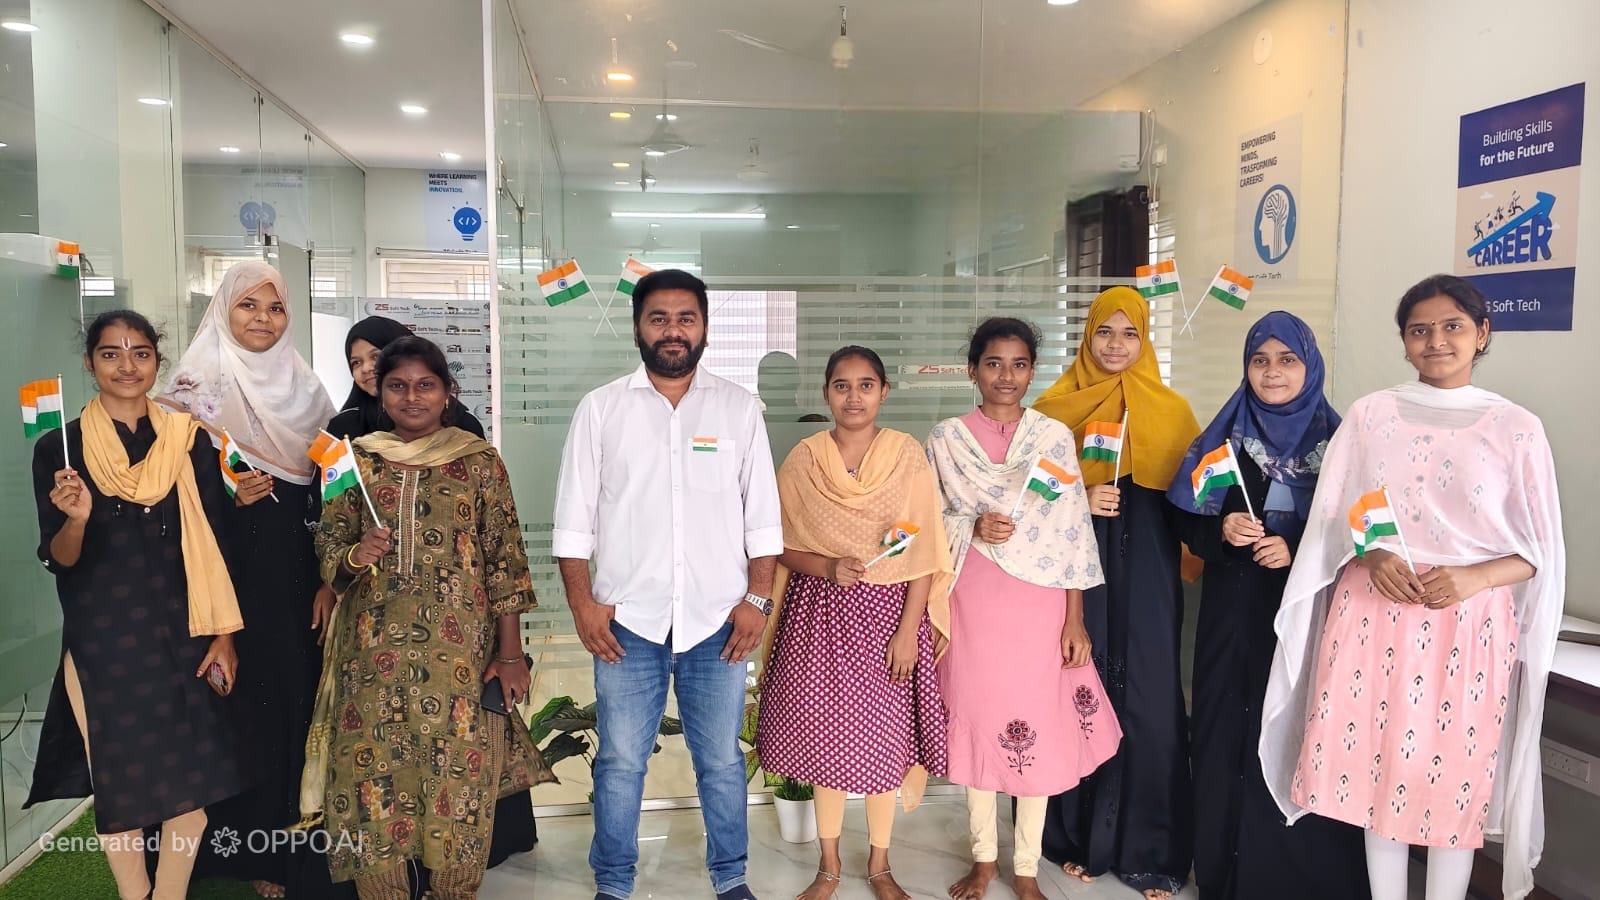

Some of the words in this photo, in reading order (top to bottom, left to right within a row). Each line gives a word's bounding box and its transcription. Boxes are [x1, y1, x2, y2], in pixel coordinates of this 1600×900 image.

[1241, 131, 1276, 151] EMPOWERING
[1483, 127, 1523, 147] Building
[1525, 118, 1553, 138] Skills
[1240, 150, 1259, 163] MINDS,
[1480, 153, 1495, 167] for
[1497, 147, 1515, 163] the
[1517, 141, 1555, 160] Future
[1240, 173, 1264, 188] CAREERS!
[1475, 214, 1552, 268] CAREER
[374, 303, 389, 311] ZS
[1492, 299, 1514, 313] Soft
[1516, 298, 1541, 311] Tech
